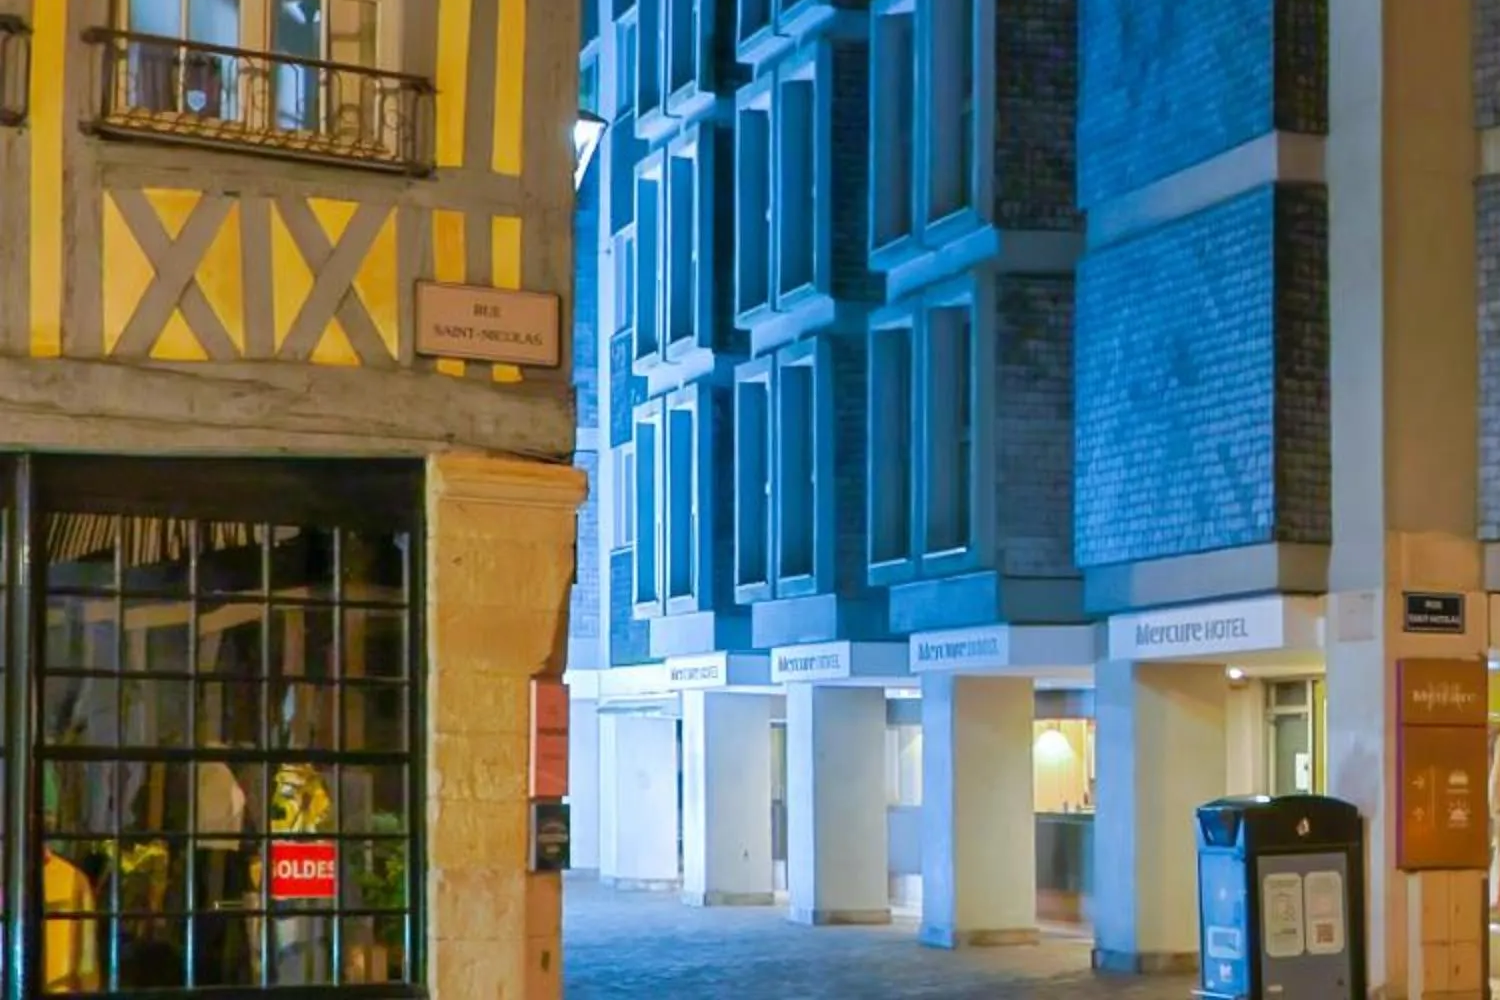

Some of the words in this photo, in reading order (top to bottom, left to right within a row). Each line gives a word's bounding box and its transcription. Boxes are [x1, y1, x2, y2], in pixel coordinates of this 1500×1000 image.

[433, 323, 544, 347] SAINT-NICOLAS
[1136, 623, 1202, 646] Mercure
[1204, 617, 1249, 641] HOTEL
